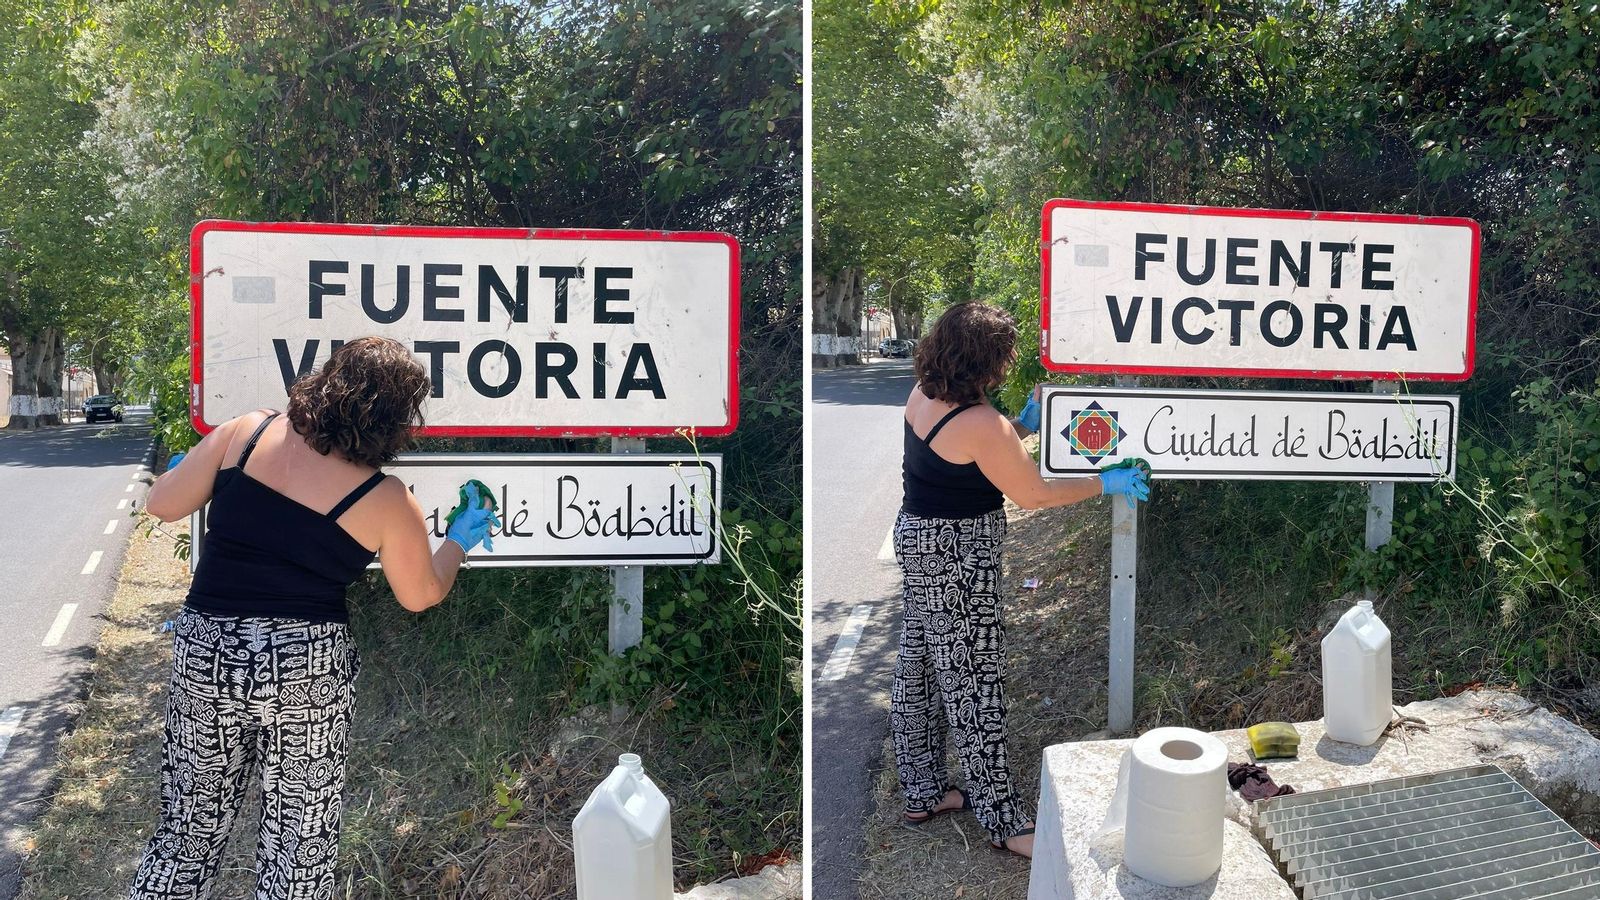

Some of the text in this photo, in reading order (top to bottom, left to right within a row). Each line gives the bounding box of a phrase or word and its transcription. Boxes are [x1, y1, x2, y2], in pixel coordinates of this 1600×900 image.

[1134, 232, 1395, 291] FUENTE
[308, 260, 635, 325] FUENTE
[1105, 295, 1418, 352] VICTORIA
[271, 338, 667, 400] VTORIA
[1143, 404, 1260, 463] Ciudad
